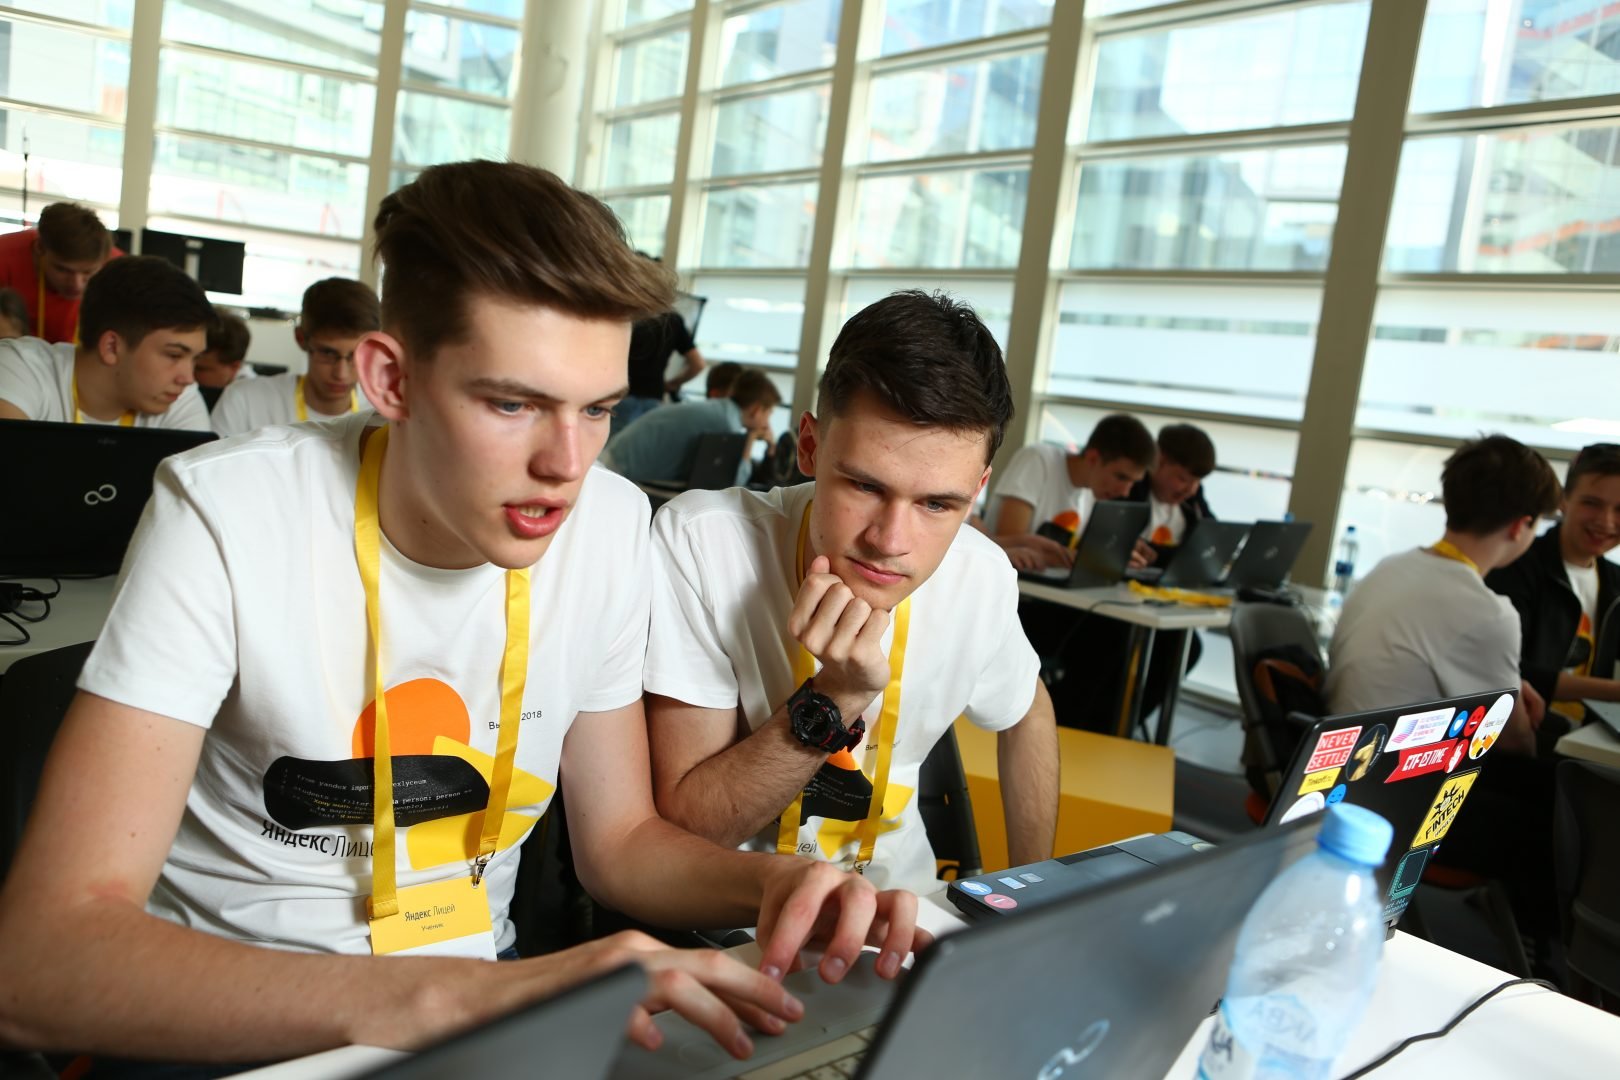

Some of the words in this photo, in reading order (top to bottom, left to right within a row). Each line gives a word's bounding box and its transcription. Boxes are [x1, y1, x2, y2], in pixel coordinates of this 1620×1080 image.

[521, 710, 542, 721] 2018
[1319, 732, 1357, 750] NEVER
[1308, 750, 1350, 768] SETTLE
[392, 779, 427, 789] exlyceum
[1425, 789, 1465, 840] FINTECH
[261, 820, 330, 854] Яндекс
[331, 835, 374, 859] Лиц
[404, 909, 432, 922] Яндекс
[433, 903, 456, 916] Лицей
